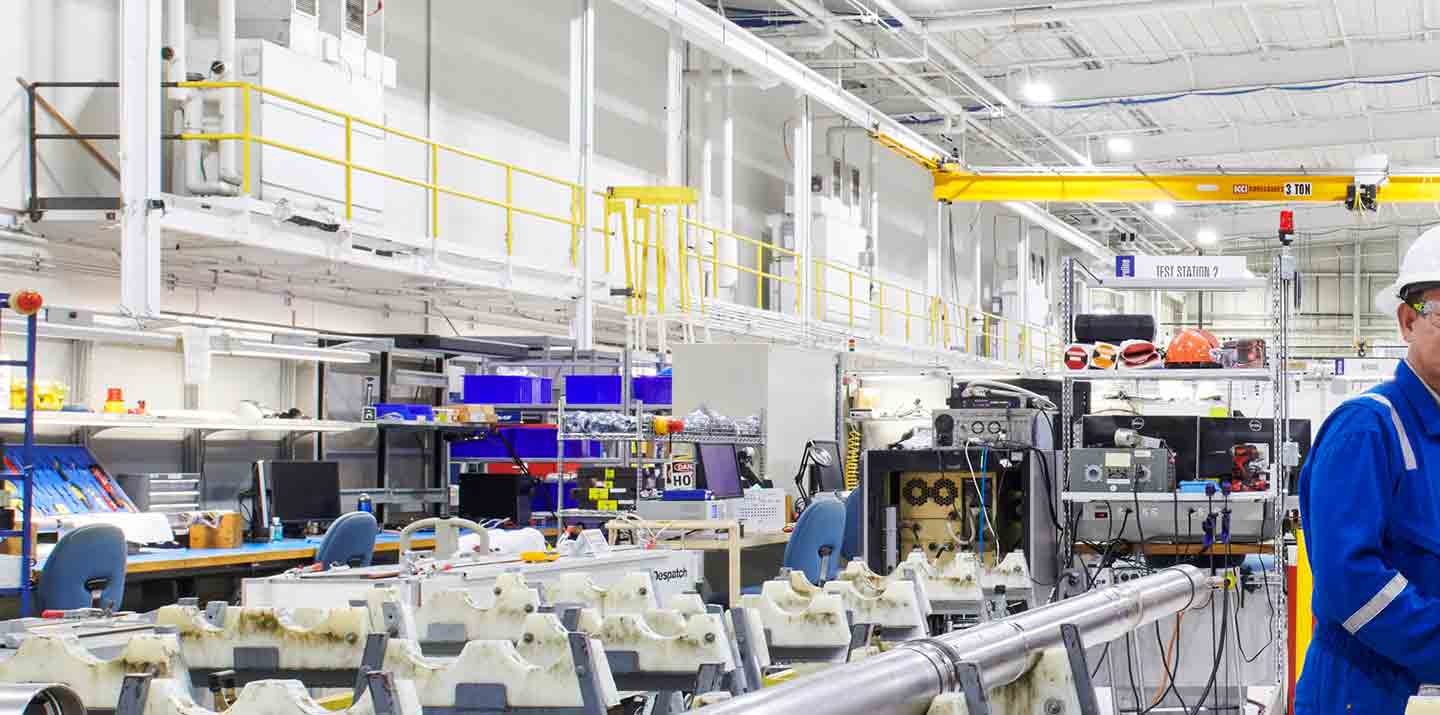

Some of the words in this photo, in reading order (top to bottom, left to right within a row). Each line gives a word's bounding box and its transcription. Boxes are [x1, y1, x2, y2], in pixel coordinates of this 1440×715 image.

[1286, 184, 1292, 194] 3
[1295, 184, 1311, 194] TON
[1157, 265, 1174, 278] TEST
[1177, 265, 1210, 278] STATION
[673, 475, 693, 486] HO
